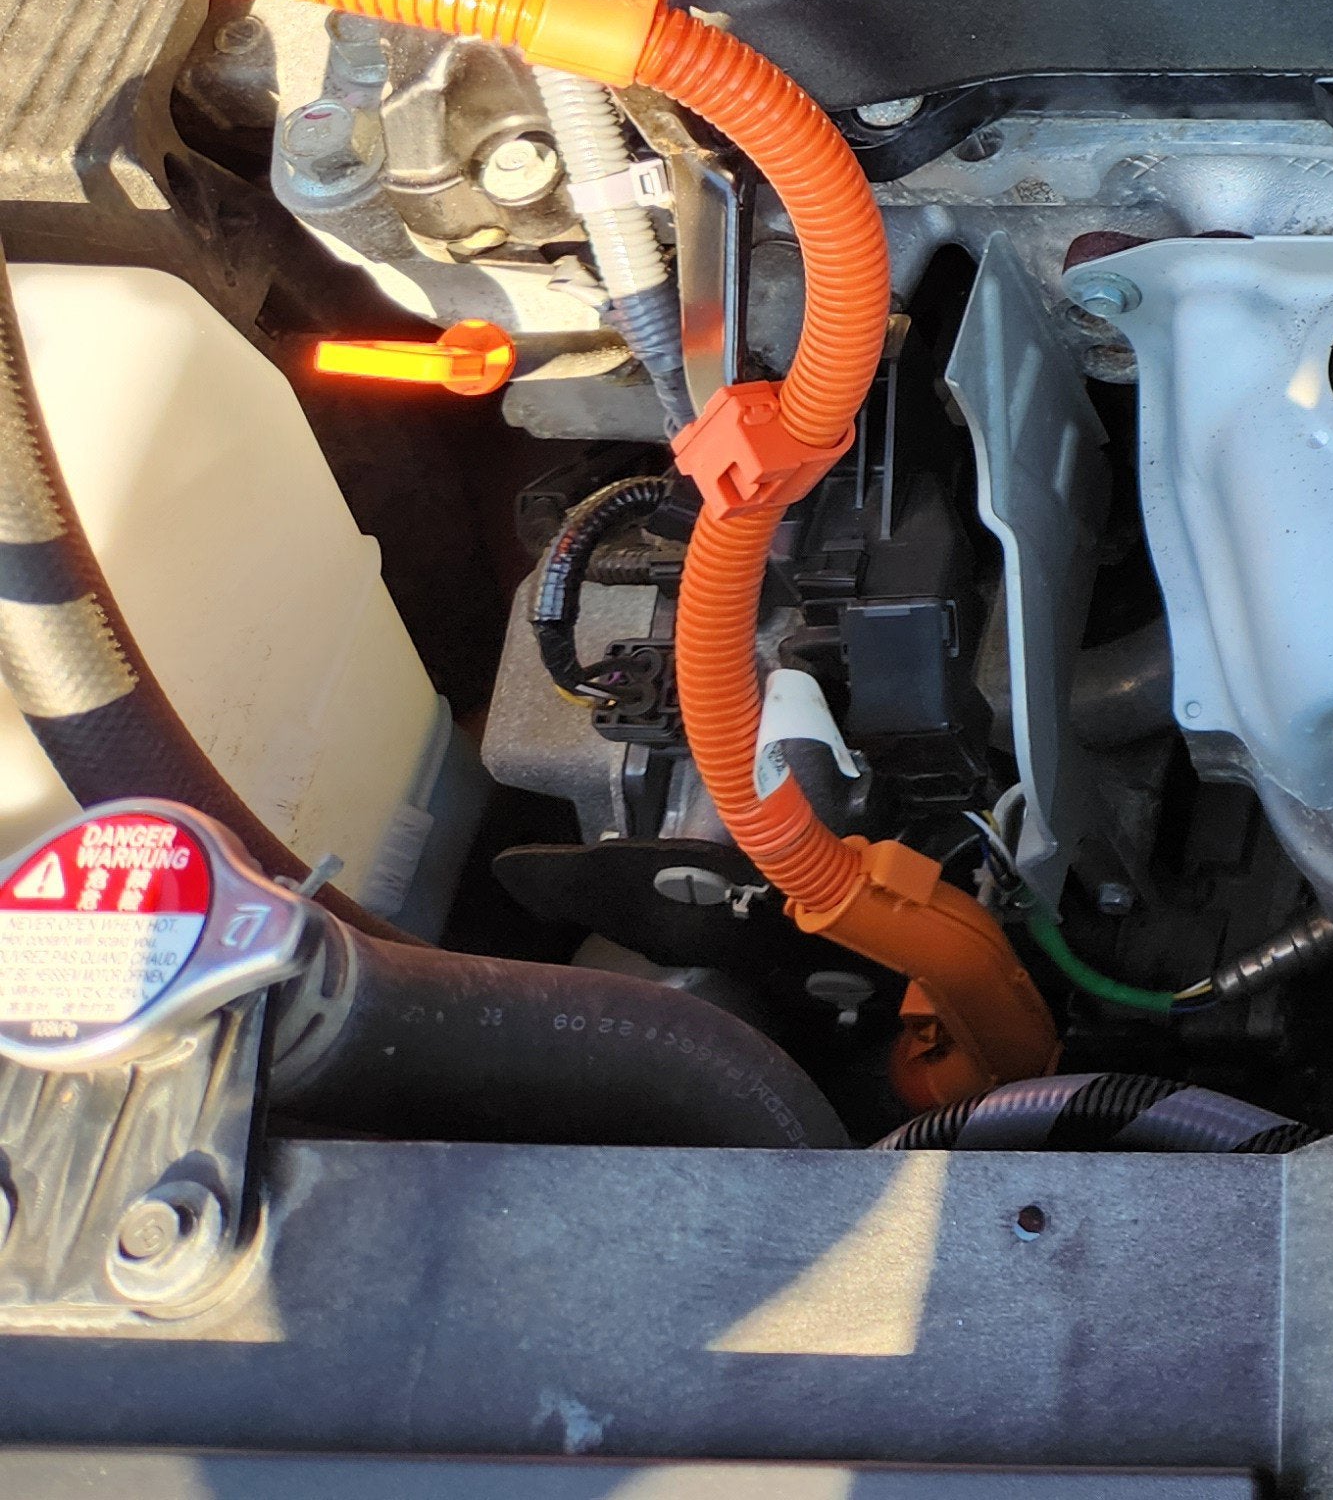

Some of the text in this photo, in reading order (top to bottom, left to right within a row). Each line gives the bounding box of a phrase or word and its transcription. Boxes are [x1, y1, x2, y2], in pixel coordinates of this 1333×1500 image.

[82, 824, 178, 847] DANGER
[76, 846, 191, 870] WARNUNG
[8, 917, 54, 931] NEVER
[58, 917, 96, 931] OPEN
[100, 918, 145, 931] WHEN
